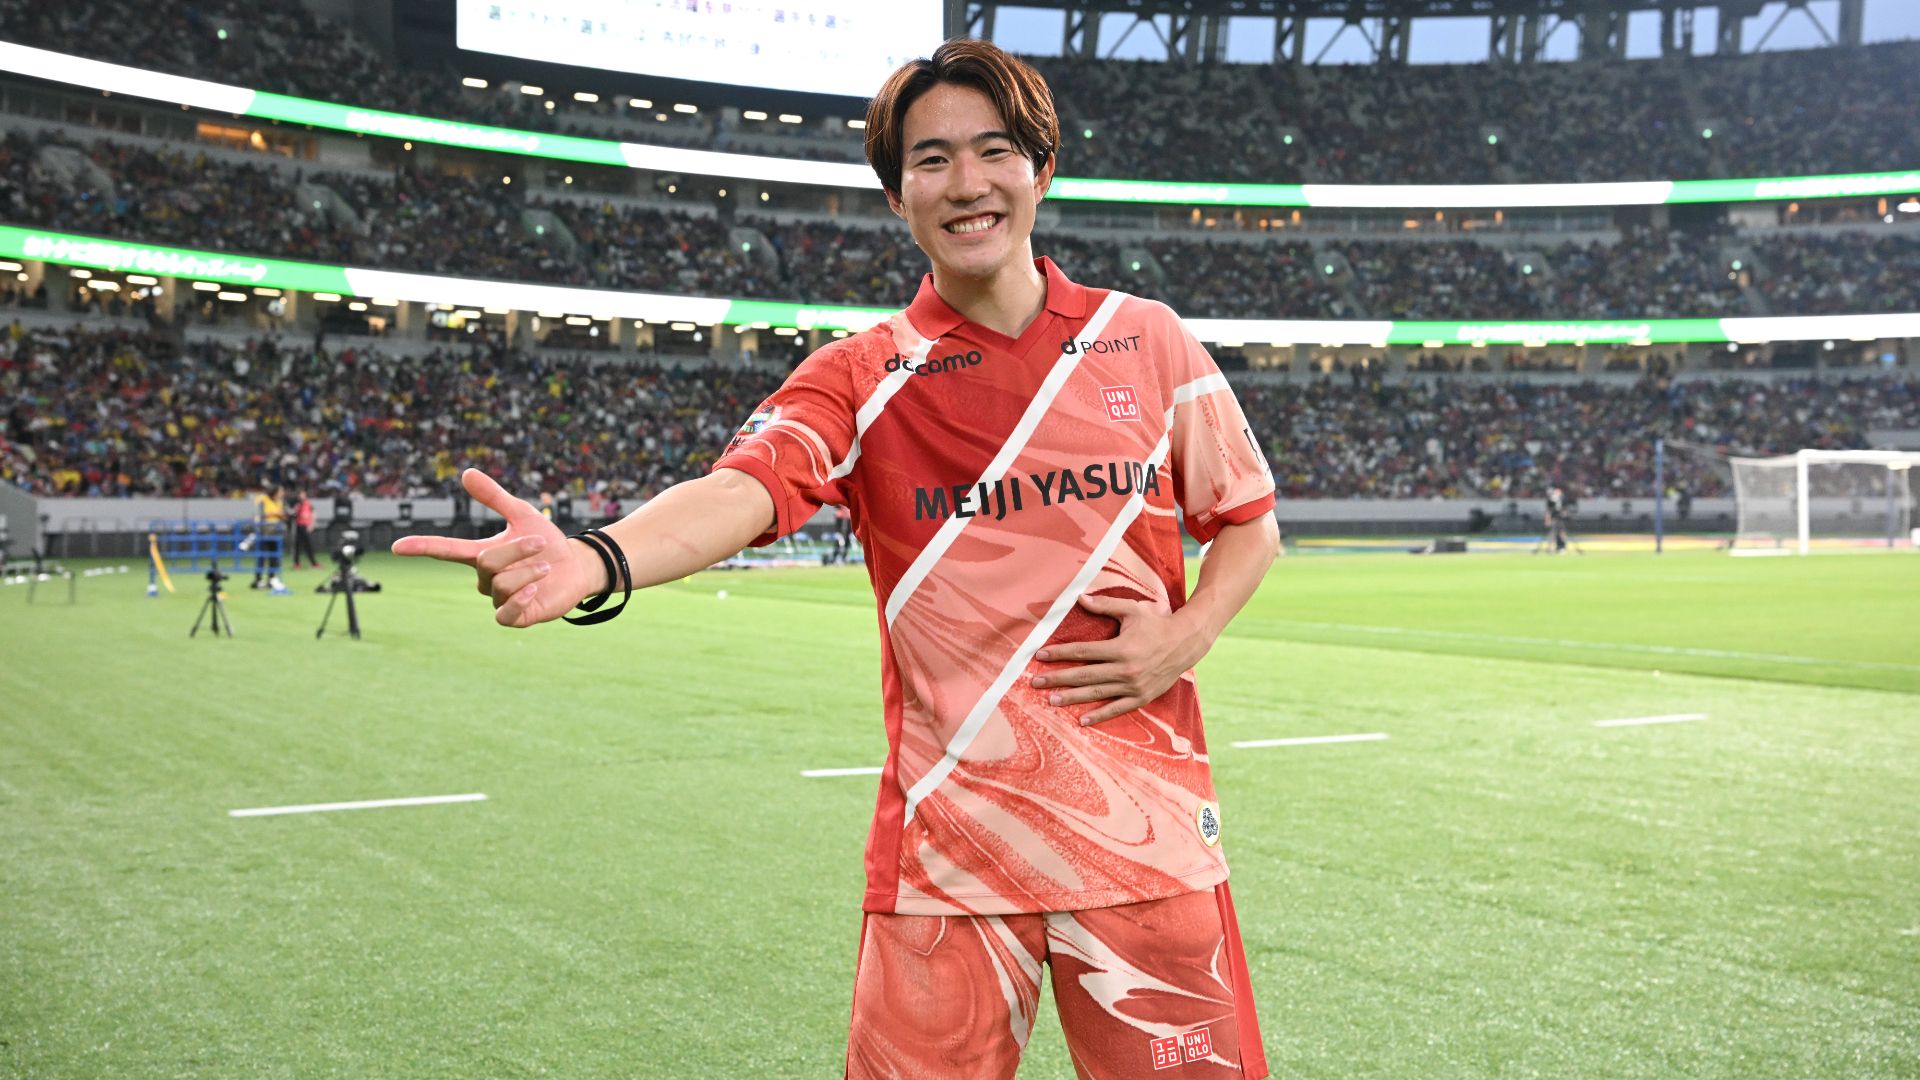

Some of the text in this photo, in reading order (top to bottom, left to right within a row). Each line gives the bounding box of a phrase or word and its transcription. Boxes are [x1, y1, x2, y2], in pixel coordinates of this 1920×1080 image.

[1080, 335, 1141, 355] POINT
[884, 350, 983, 377] docomo
[1105, 390, 1132, 403] UNI
[1111, 403, 1137, 418] QLO
[914, 461, 1161, 522] MEIJI YASUDA
[1186, 1033, 1206, 1045] UNI
[1188, 1044, 1209, 1059] QLO
